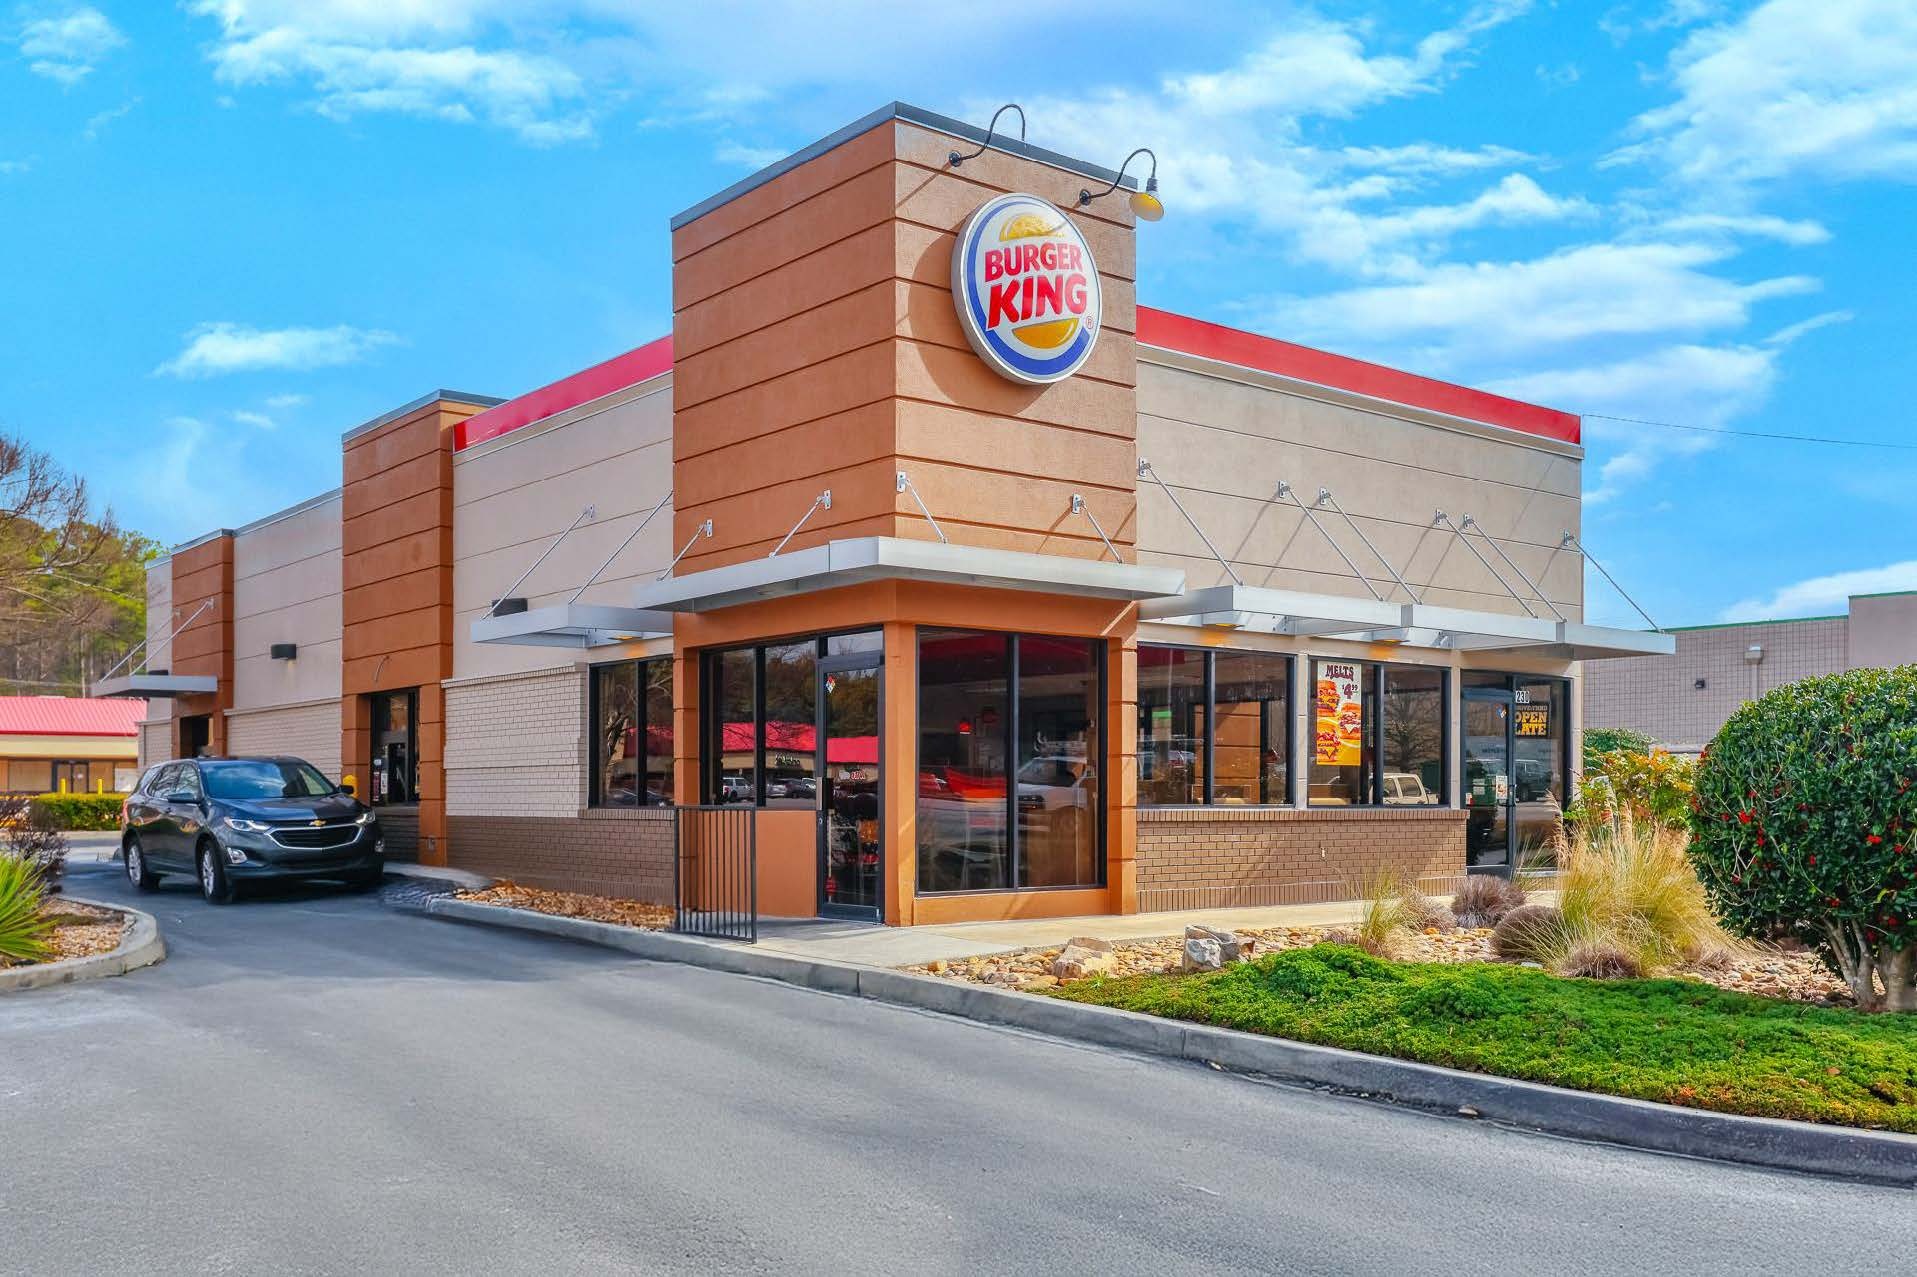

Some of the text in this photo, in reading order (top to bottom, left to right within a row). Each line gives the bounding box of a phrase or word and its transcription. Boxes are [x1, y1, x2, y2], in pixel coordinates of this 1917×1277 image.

[985, 241, 1083, 282] BURGER
[987, 273, 1087, 329] KING
[1325, 664, 1354, 681] MELTS
[1515, 711, 1547, 723] OPEN
[1515, 723, 1547, 735] LATE
